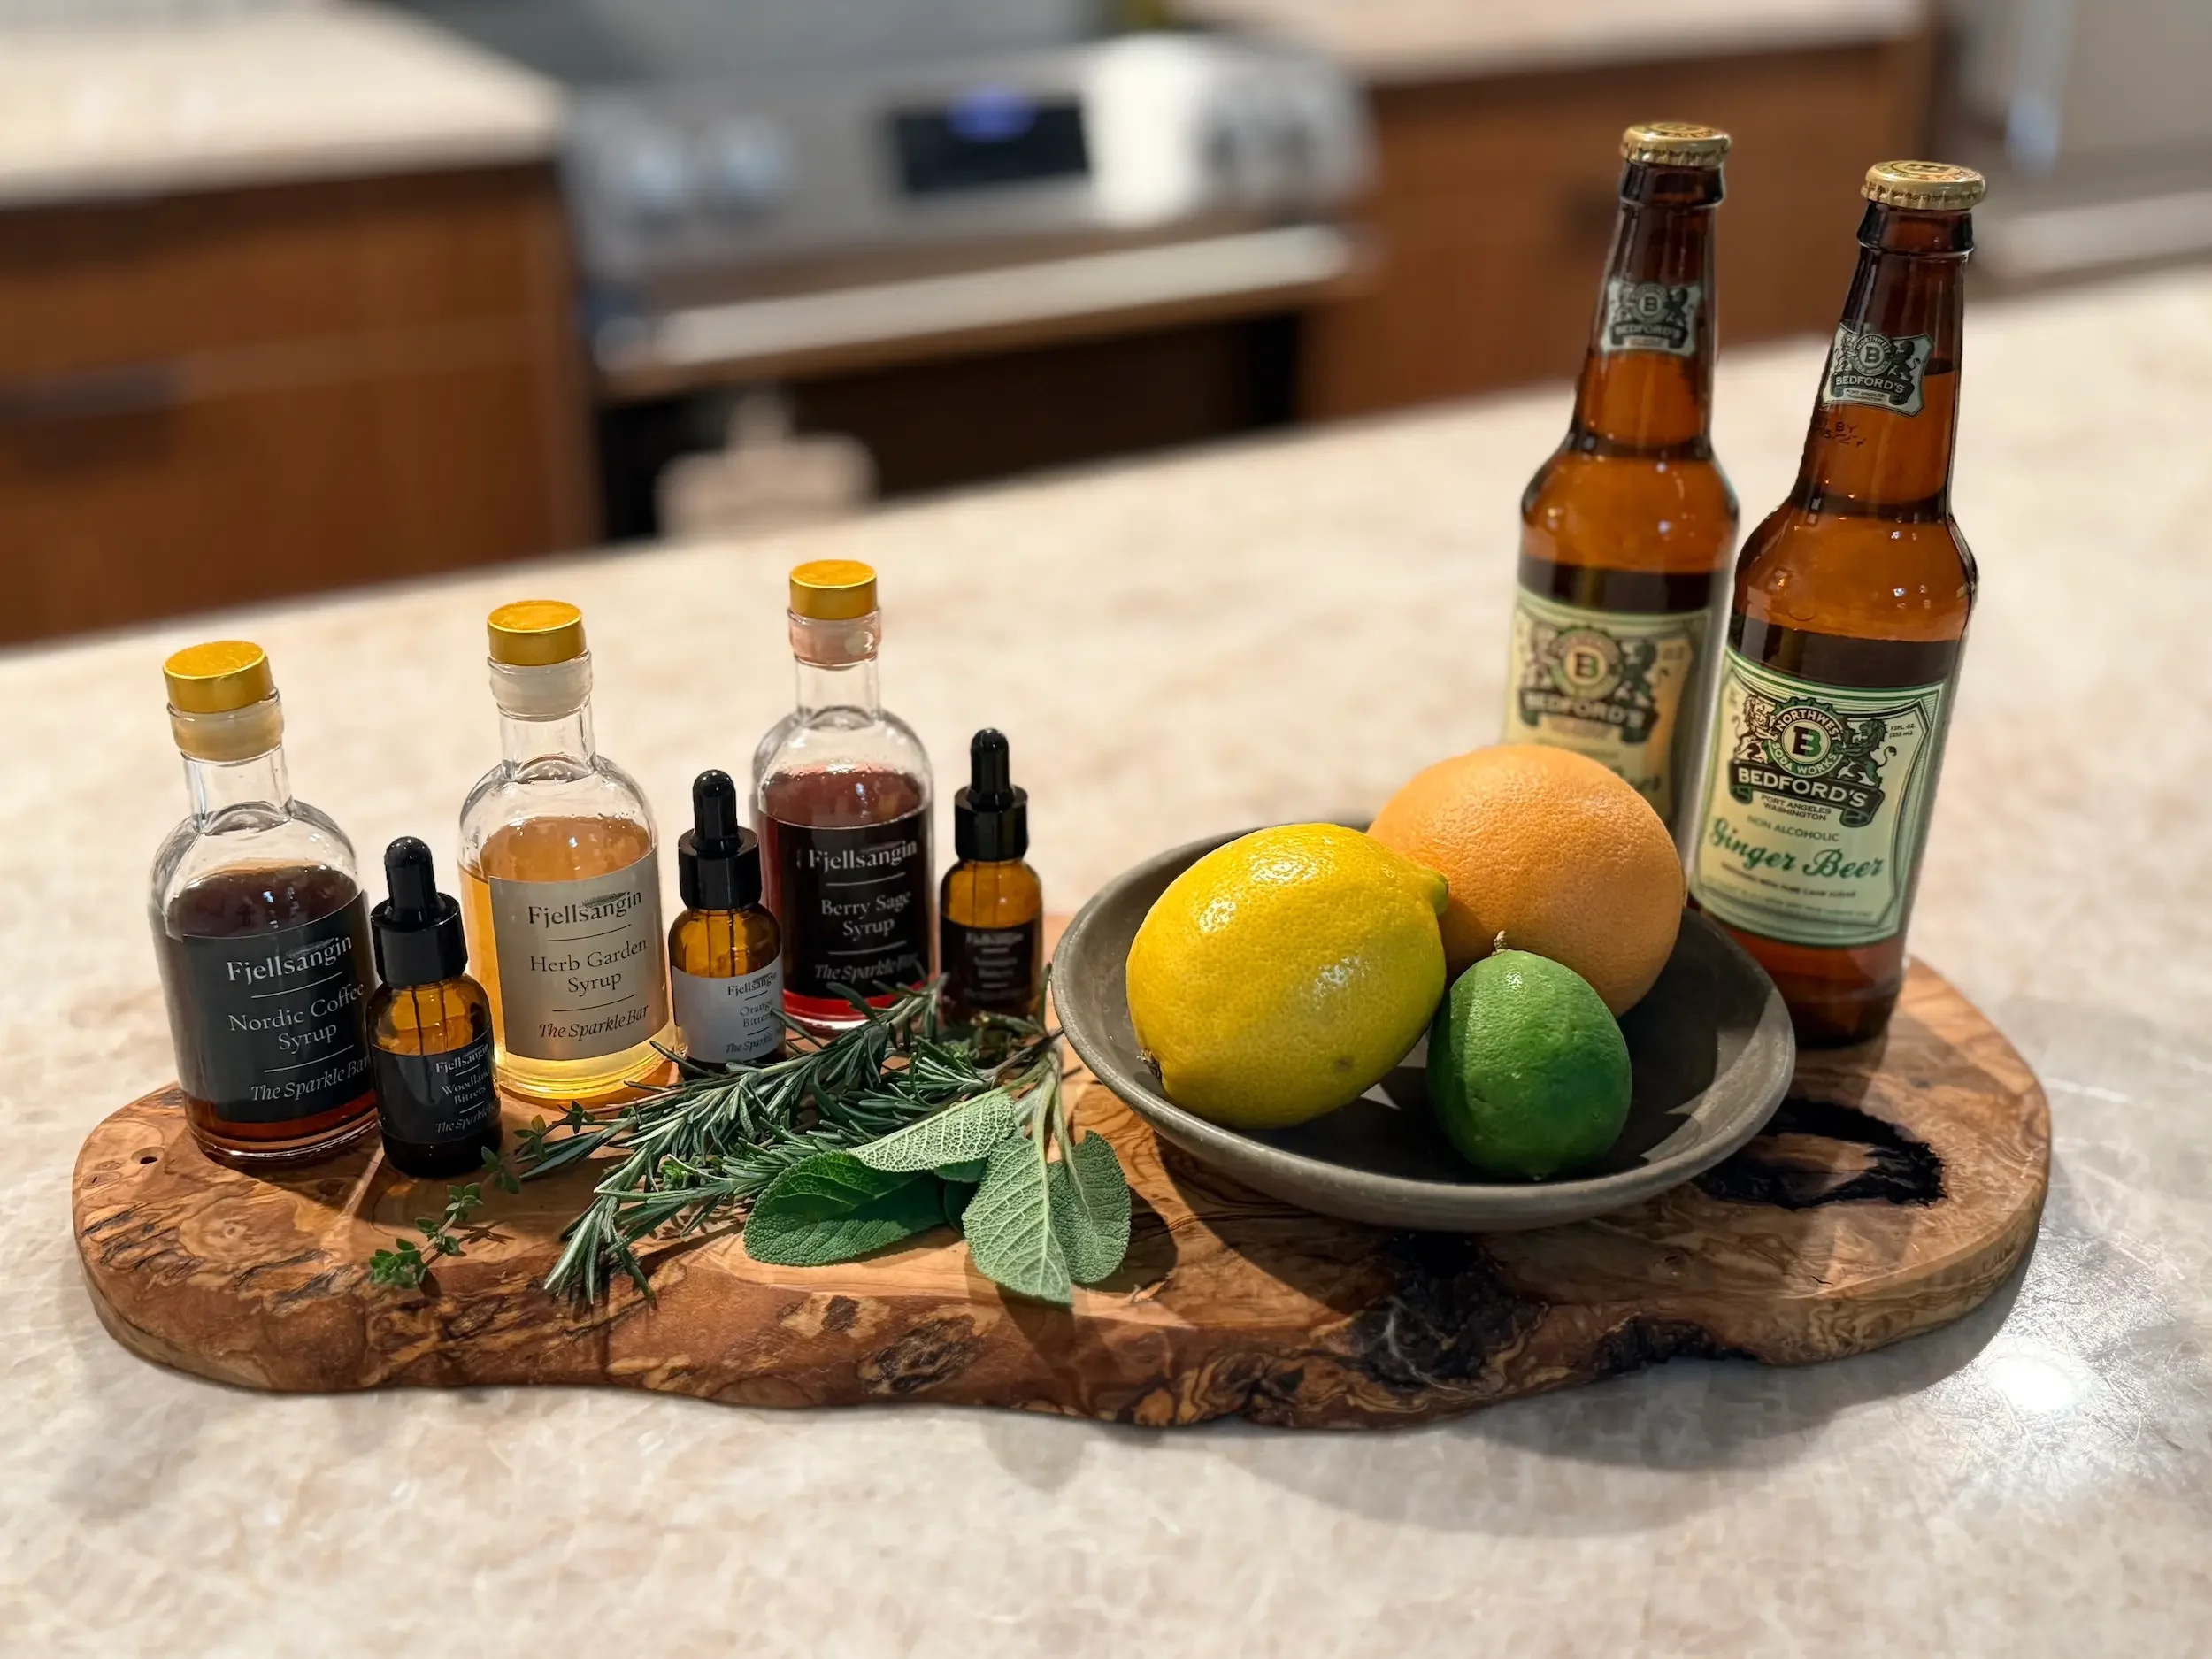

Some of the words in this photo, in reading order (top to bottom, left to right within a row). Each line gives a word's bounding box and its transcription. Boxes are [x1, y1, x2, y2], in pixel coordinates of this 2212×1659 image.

[1864, 346, 1881, 364] B
[1835, 375, 1905, 394] BEDFORD'S
[1775, 709, 1842, 741] NORTHWEST
[1792, 726, 1822, 757] B
[1771, 742, 1793, 771] SODA
[1796, 753, 1838, 774] WORKS
[1737, 767, 1869, 808] BEDFORD'S
[1761, 794, 1786, 805] PORT
[1786, 802, 1832, 814] ANGELES
[1763, 802, 1827, 821] WASHINGTON
[1747, 814, 1771, 829] NON
[1773, 824, 1840, 842] ALCOHOLIC
[809, 841, 918, 873] Fjellsangin
[1709, 817, 1797, 871] Ginger
[1801, 847, 1885, 879] Beer
[527, 891, 642, 929] Fjellsangin
[820, 898, 871, 920] Berry
[875, 890, 912, 913] Sage
[842, 917, 895, 941] Syrup
[227, 935, 353, 985] Fjellsangin
[530, 953, 580, 973] Herb
[587, 938, 648, 968] Garden
[567, 972, 622, 997] Syrup
[727, 971, 777, 997] Fjellsangin
[815, 964, 841, 979] The
[228, 1008, 305, 1032] Nordic
[310, 982, 365, 1018] Coffee
[539, 1022, 567, 1039] The
[567, 1013, 628, 1041] Sparkle
[626, 1002, 649, 1026] Bar
[278, 1023, 338, 1054] Syrup
[726, 1042, 742, 1054] The
[435, 1043, 489, 1073] Fjellsangin
[250, 1084, 281, 1102] The
[283, 1067, 345, 1102] Sparkle
[347, 1054, 371, 1079] Bar
[435, 1120, 453, 1133] The
